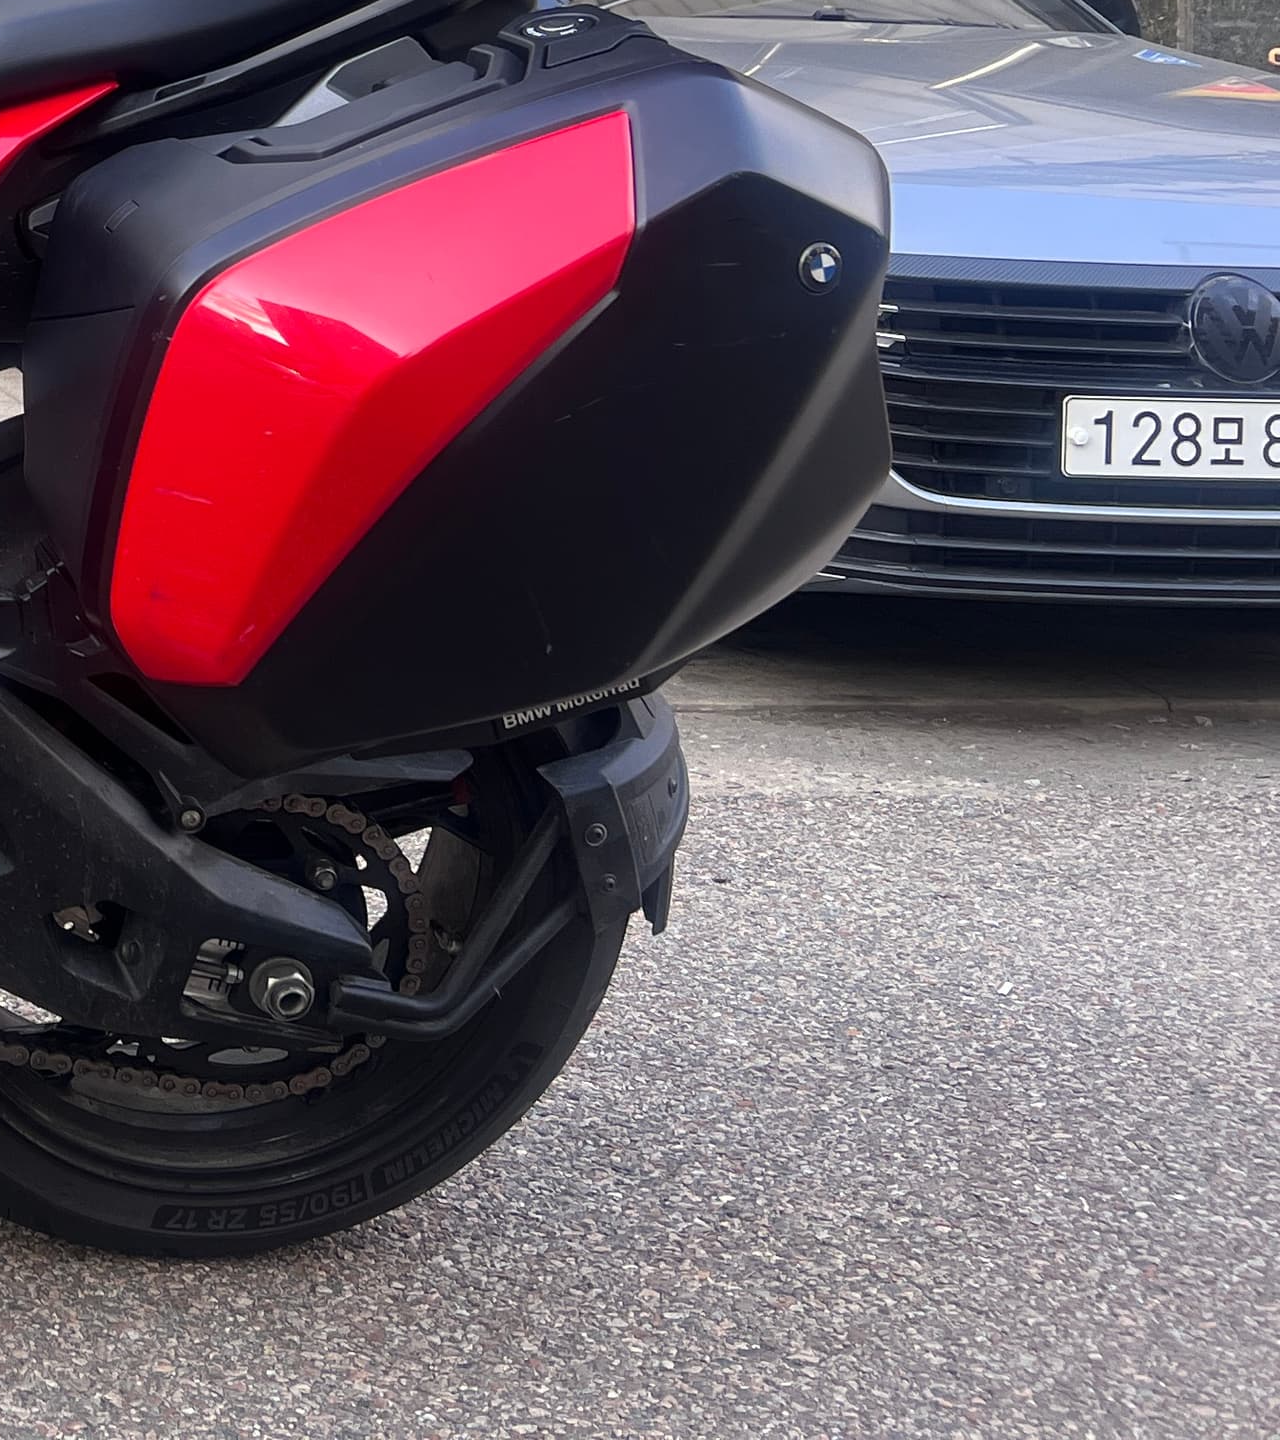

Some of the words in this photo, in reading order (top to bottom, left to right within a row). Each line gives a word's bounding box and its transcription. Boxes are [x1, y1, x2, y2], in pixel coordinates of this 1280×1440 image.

[502, 704, 551, 730] BMW
[383, 1083, 506, 1185] MICHELIN
[259, 1182, 364, 1227] 190/55
[166, 1210, 197, 1230] 17
[207, 1212, 246, 1230] ZR
